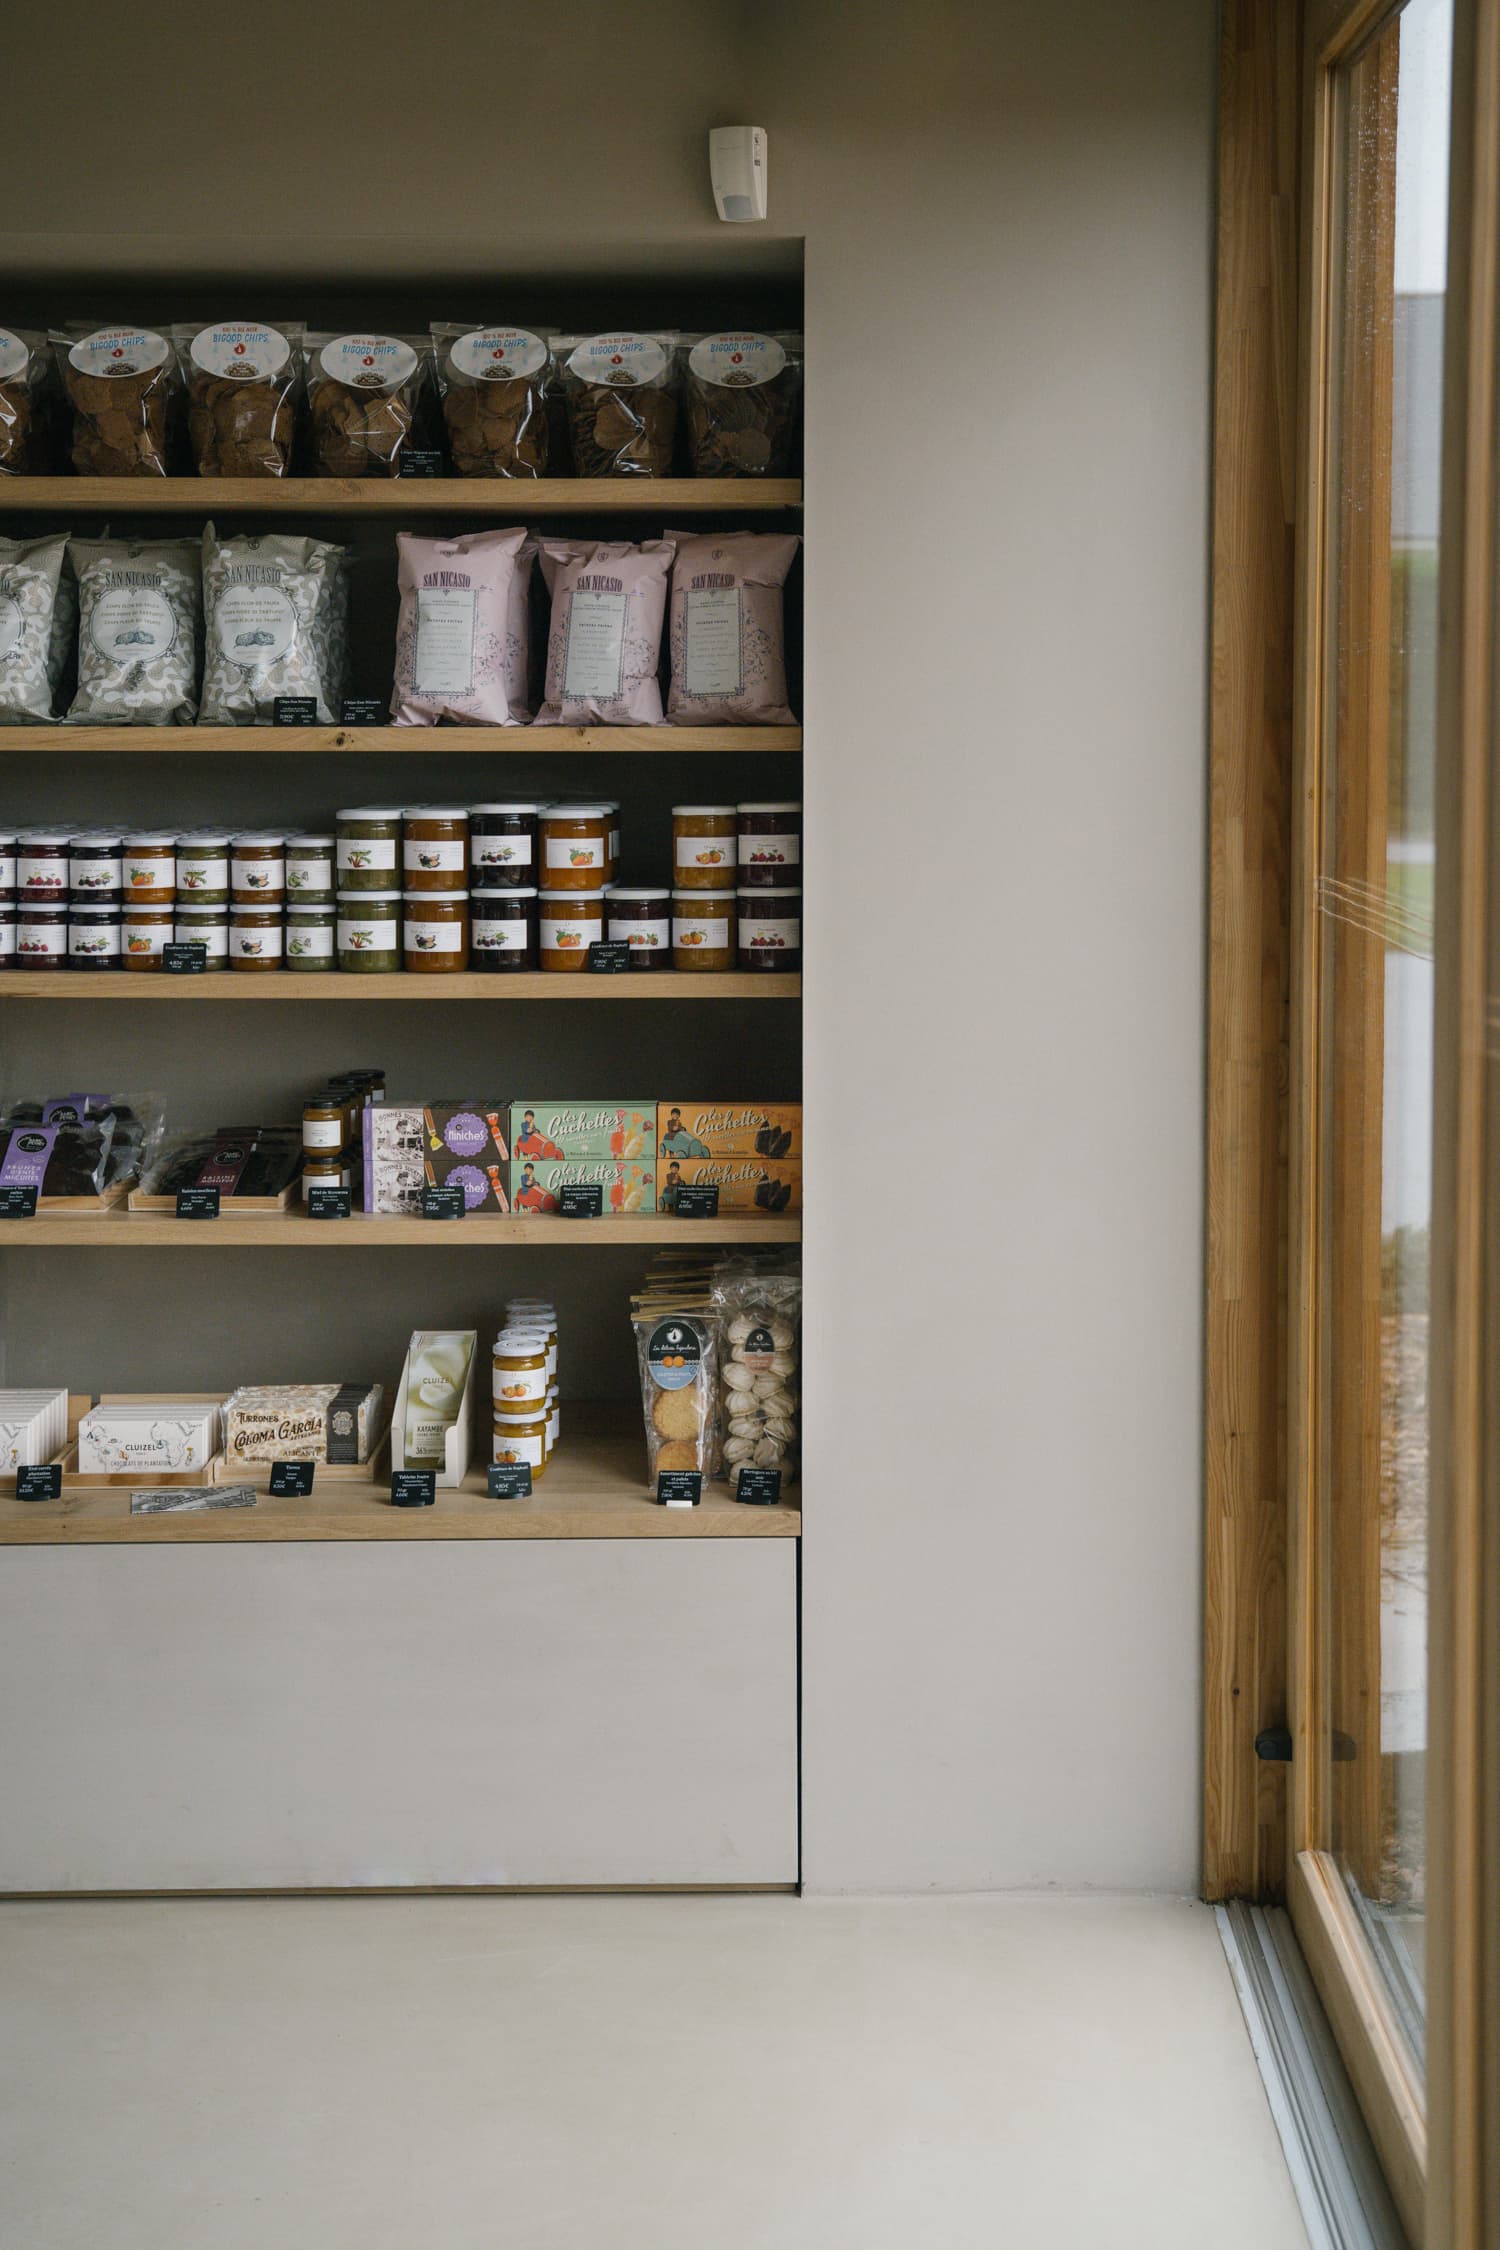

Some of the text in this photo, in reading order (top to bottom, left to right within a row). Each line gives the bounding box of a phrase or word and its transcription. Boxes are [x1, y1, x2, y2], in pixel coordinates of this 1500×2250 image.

[90, 336, 145, 351] BIGOOD CHIPS
[213, 334, 268, 343] BIGOOD CHIPS
[473, 339, 527, 348] BIGOOD CHIPS
[342, 345, 397, 355] BIGOOD CHIPS
[590, 343, 643, 355] BIGOOD CHIPS
[711, 342, 765, 352] BIGOOD CHIPS
[106, 571, 161, 586] SAN NICASIO
[225, 565, 281, 584] SAN NICASIO
[424, 571, 471, 588] SAN NICASIO
[691, 573, 735, 589] SAN NICASIO
[577, 575, 622, 592] SAN NICASIO
[548, 1111, 623, 1138] Cuchettes
[694, 1110, 768, 1136] Cuchettes
[547, 1163, 622, 1190] Cuchettes
[693, 1163, 767, 1185] Cuchettes
[236, 1412, 279, 1424] TURRONES
[235, 1430, 275, 1451] COLOMA
